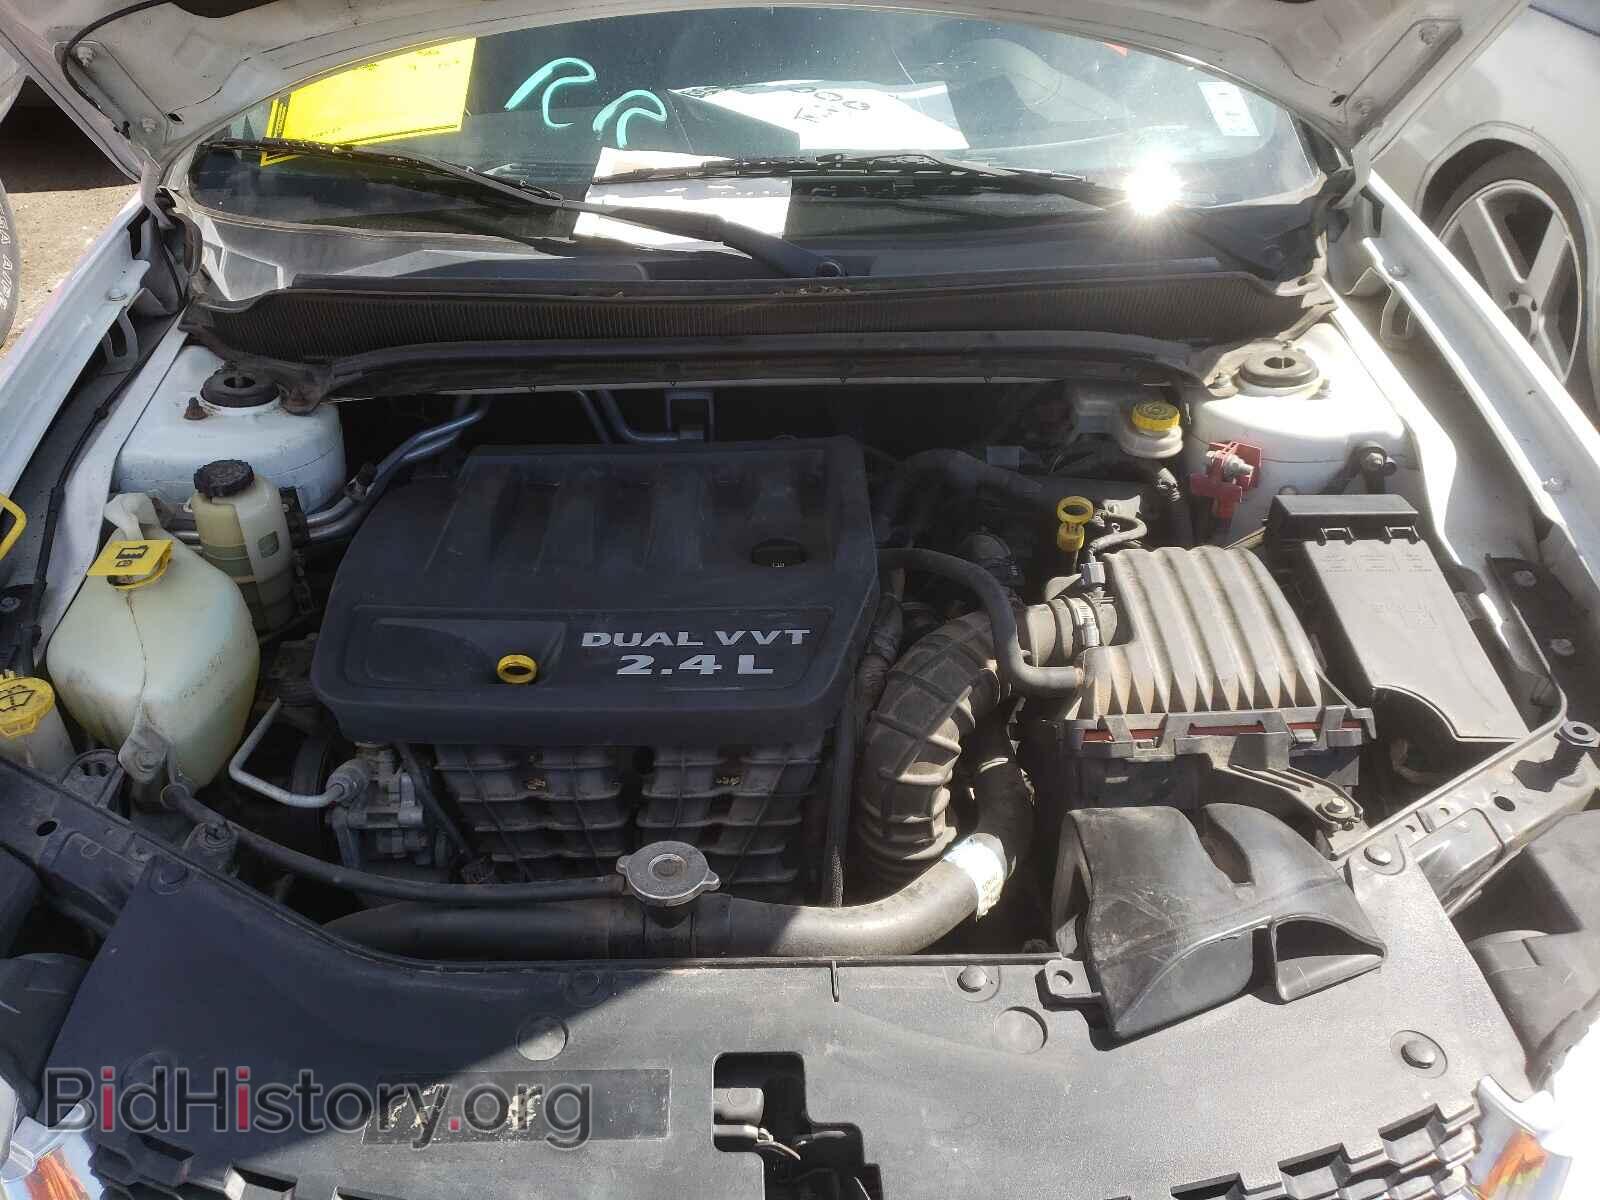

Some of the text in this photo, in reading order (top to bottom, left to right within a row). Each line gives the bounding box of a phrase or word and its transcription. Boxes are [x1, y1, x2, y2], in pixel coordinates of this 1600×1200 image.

[581, 629, 811, 647] DUAL VVT
[616, 654, 774, 675] 2.4 L
